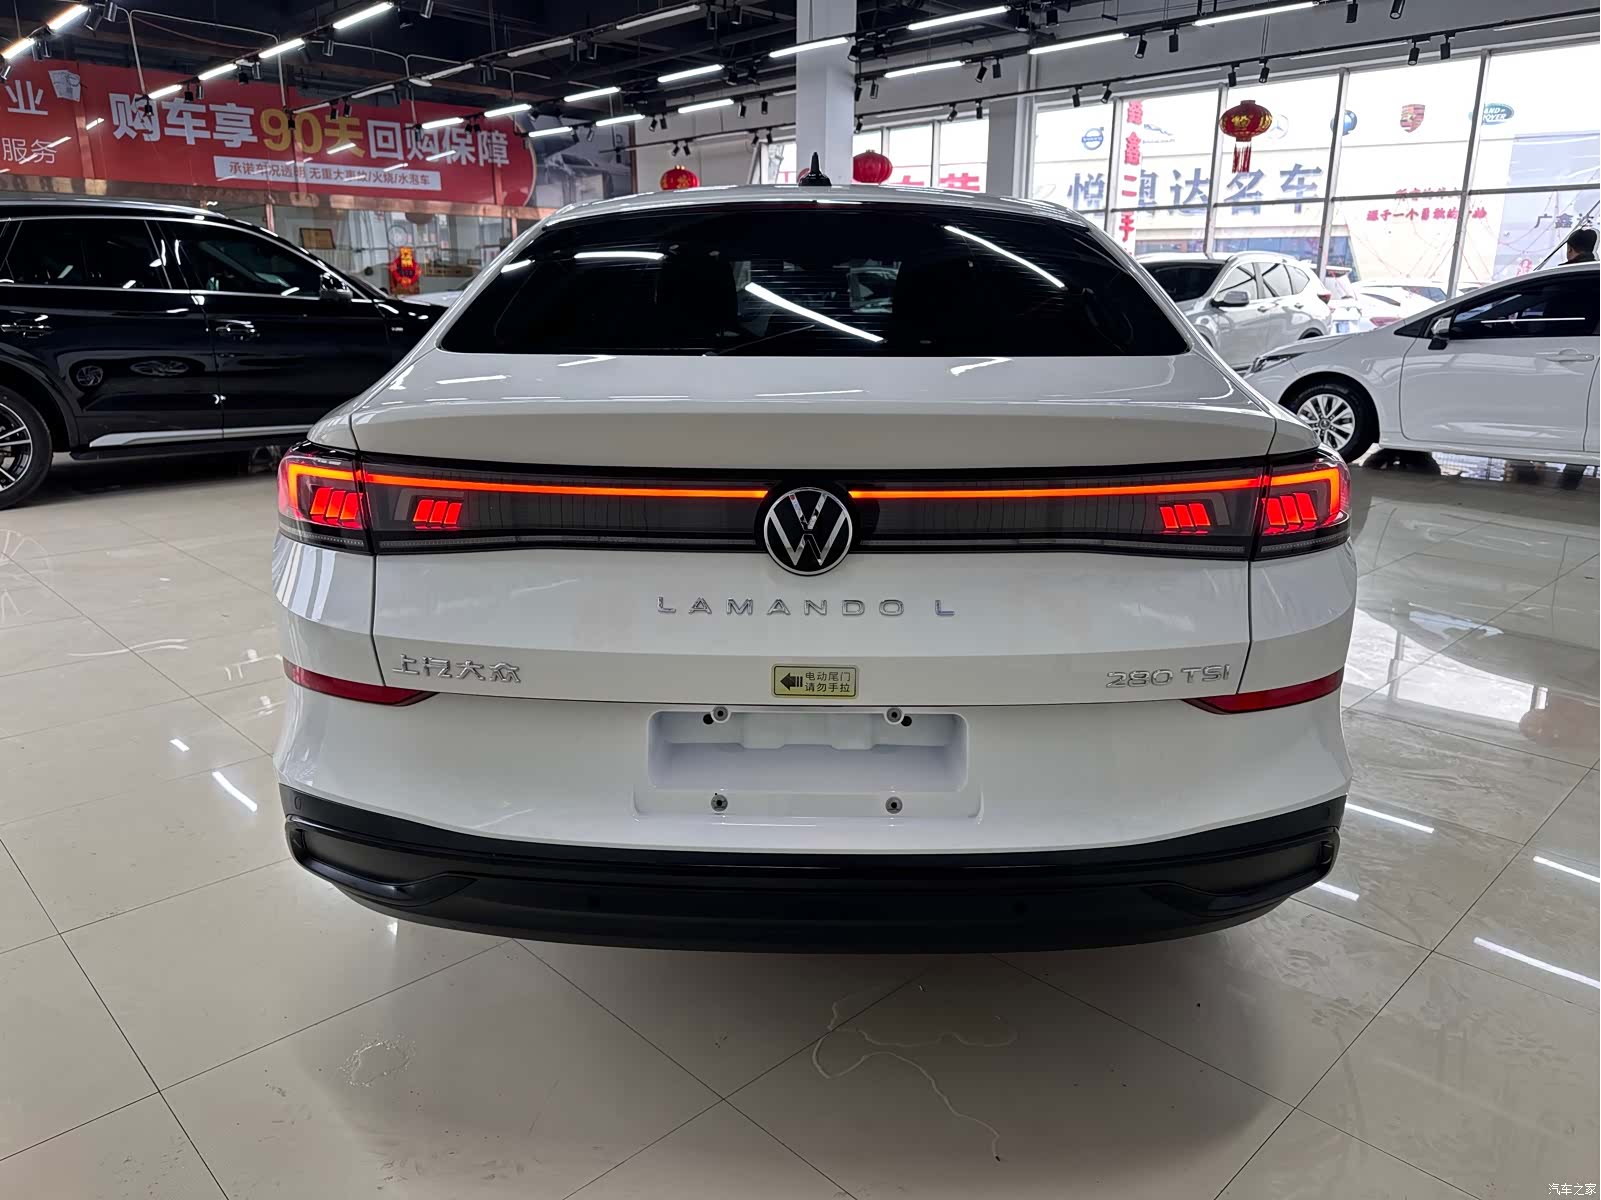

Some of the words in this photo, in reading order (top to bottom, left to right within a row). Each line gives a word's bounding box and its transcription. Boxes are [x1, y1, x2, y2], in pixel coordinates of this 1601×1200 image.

[5, 80, 48, 115] 业
[108, 92, 510, 168] 购车享90天回购保障
[2, 138, 57, 164] 服务
[656, 596, 905, 616] LAMANDO
[935, 599, 956, 616] L
[392, 654, 521, 682] 上汽大众
[805, 671, 851, 682] 电动尾门
[1106, 669, 1174, 688] 280
[1181, 664, 1231, 683] TSI
[805, 682, 851, 693] 请勿手拉
